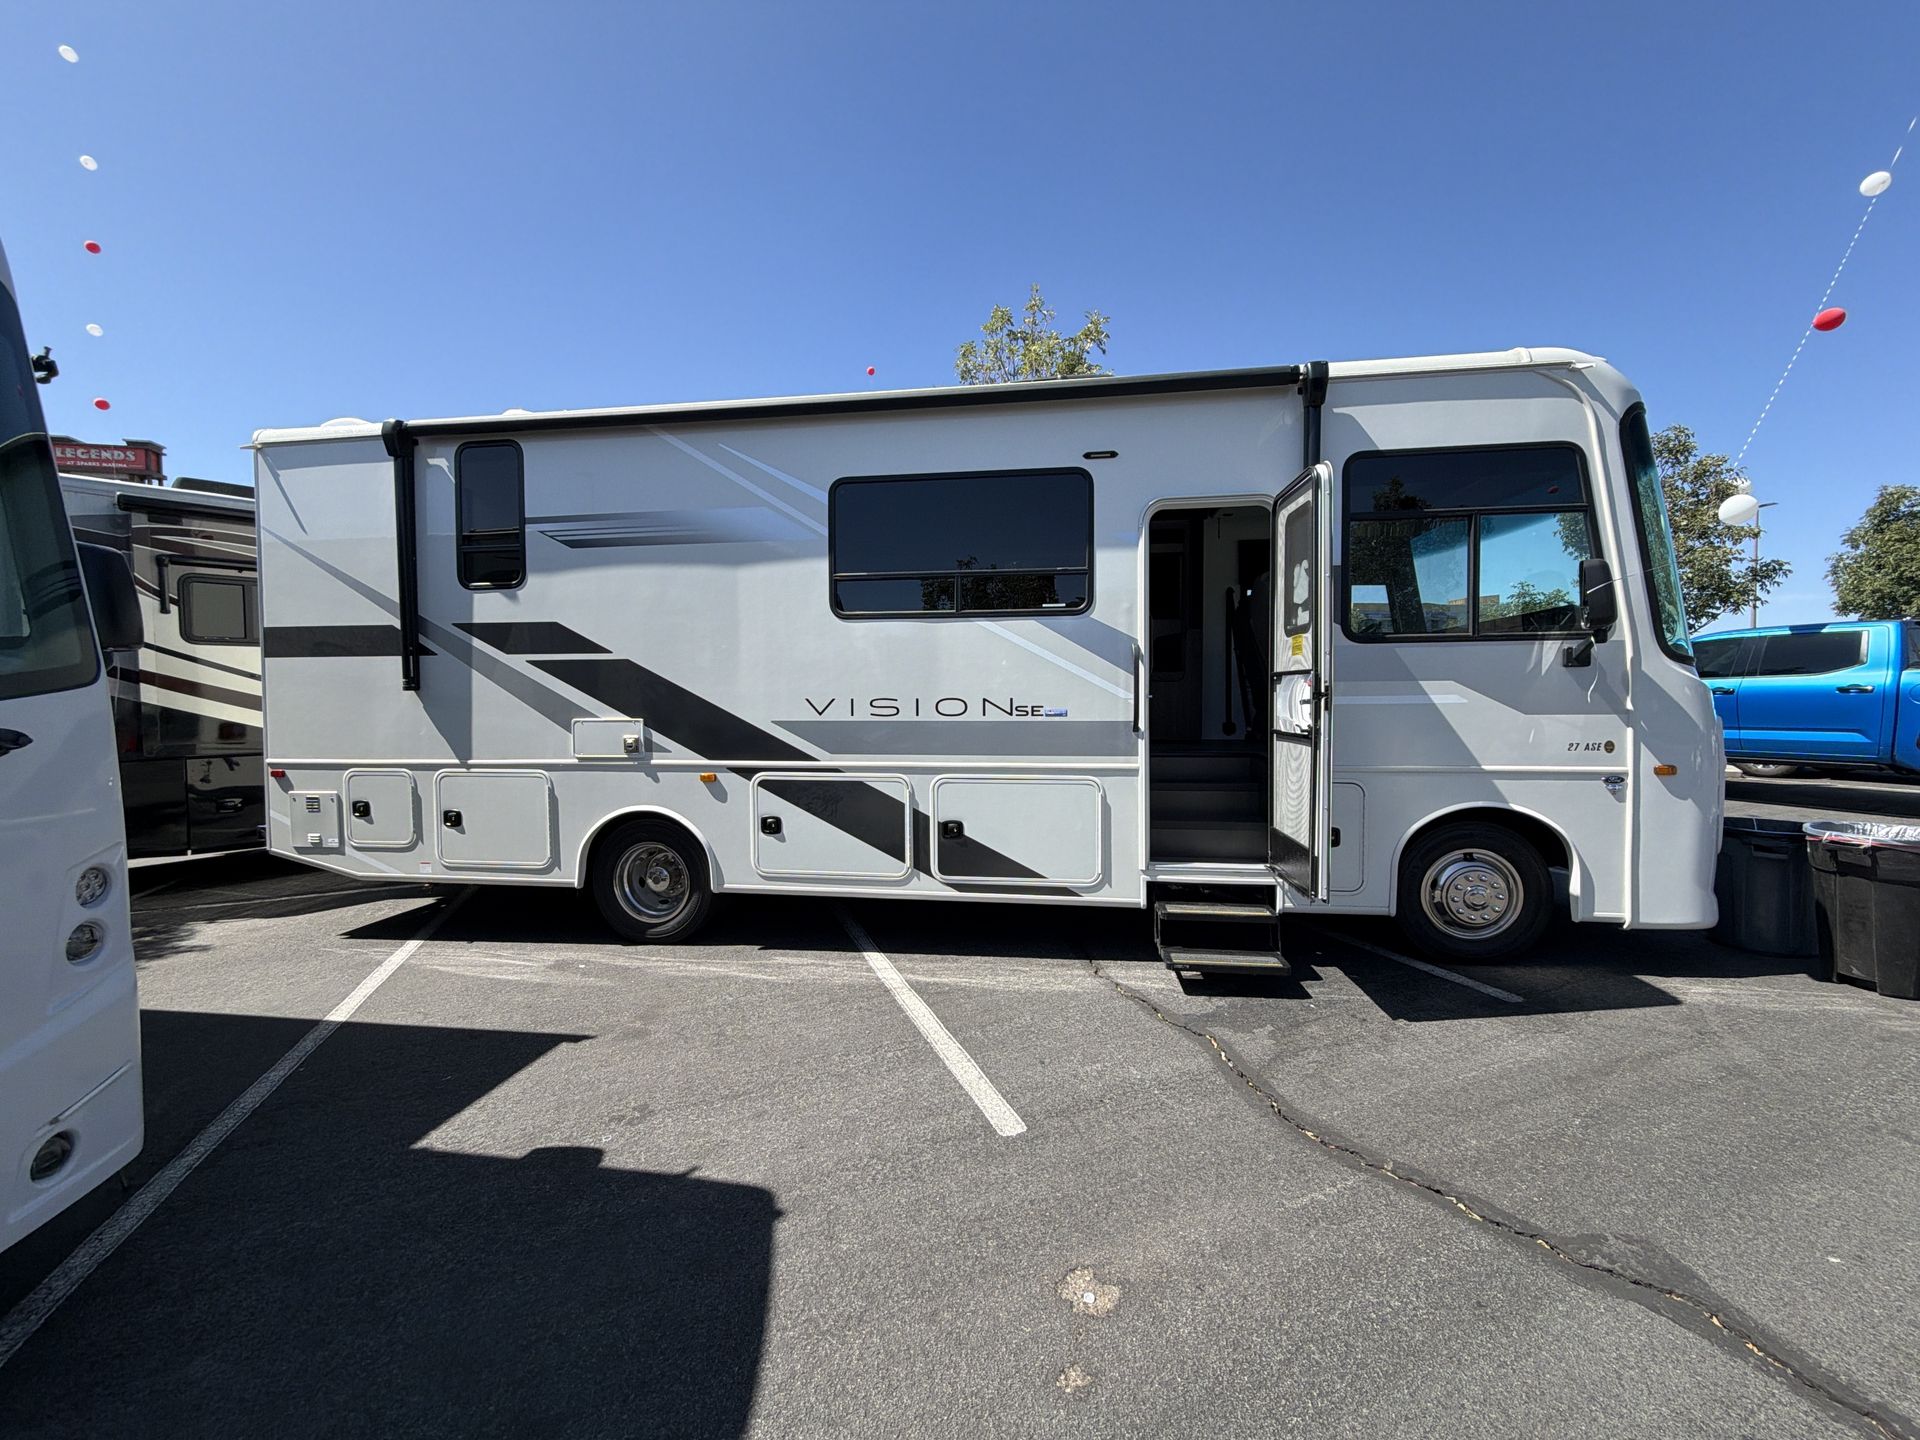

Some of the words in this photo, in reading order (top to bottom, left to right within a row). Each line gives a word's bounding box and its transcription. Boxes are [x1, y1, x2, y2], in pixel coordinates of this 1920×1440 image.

[55, 447, 136, 461] LEGENDS
[805, 698, 1014, 717] VISION
[1567, 742, 1581, 752] 27
[1584, 742, 1602, 752] ASE
